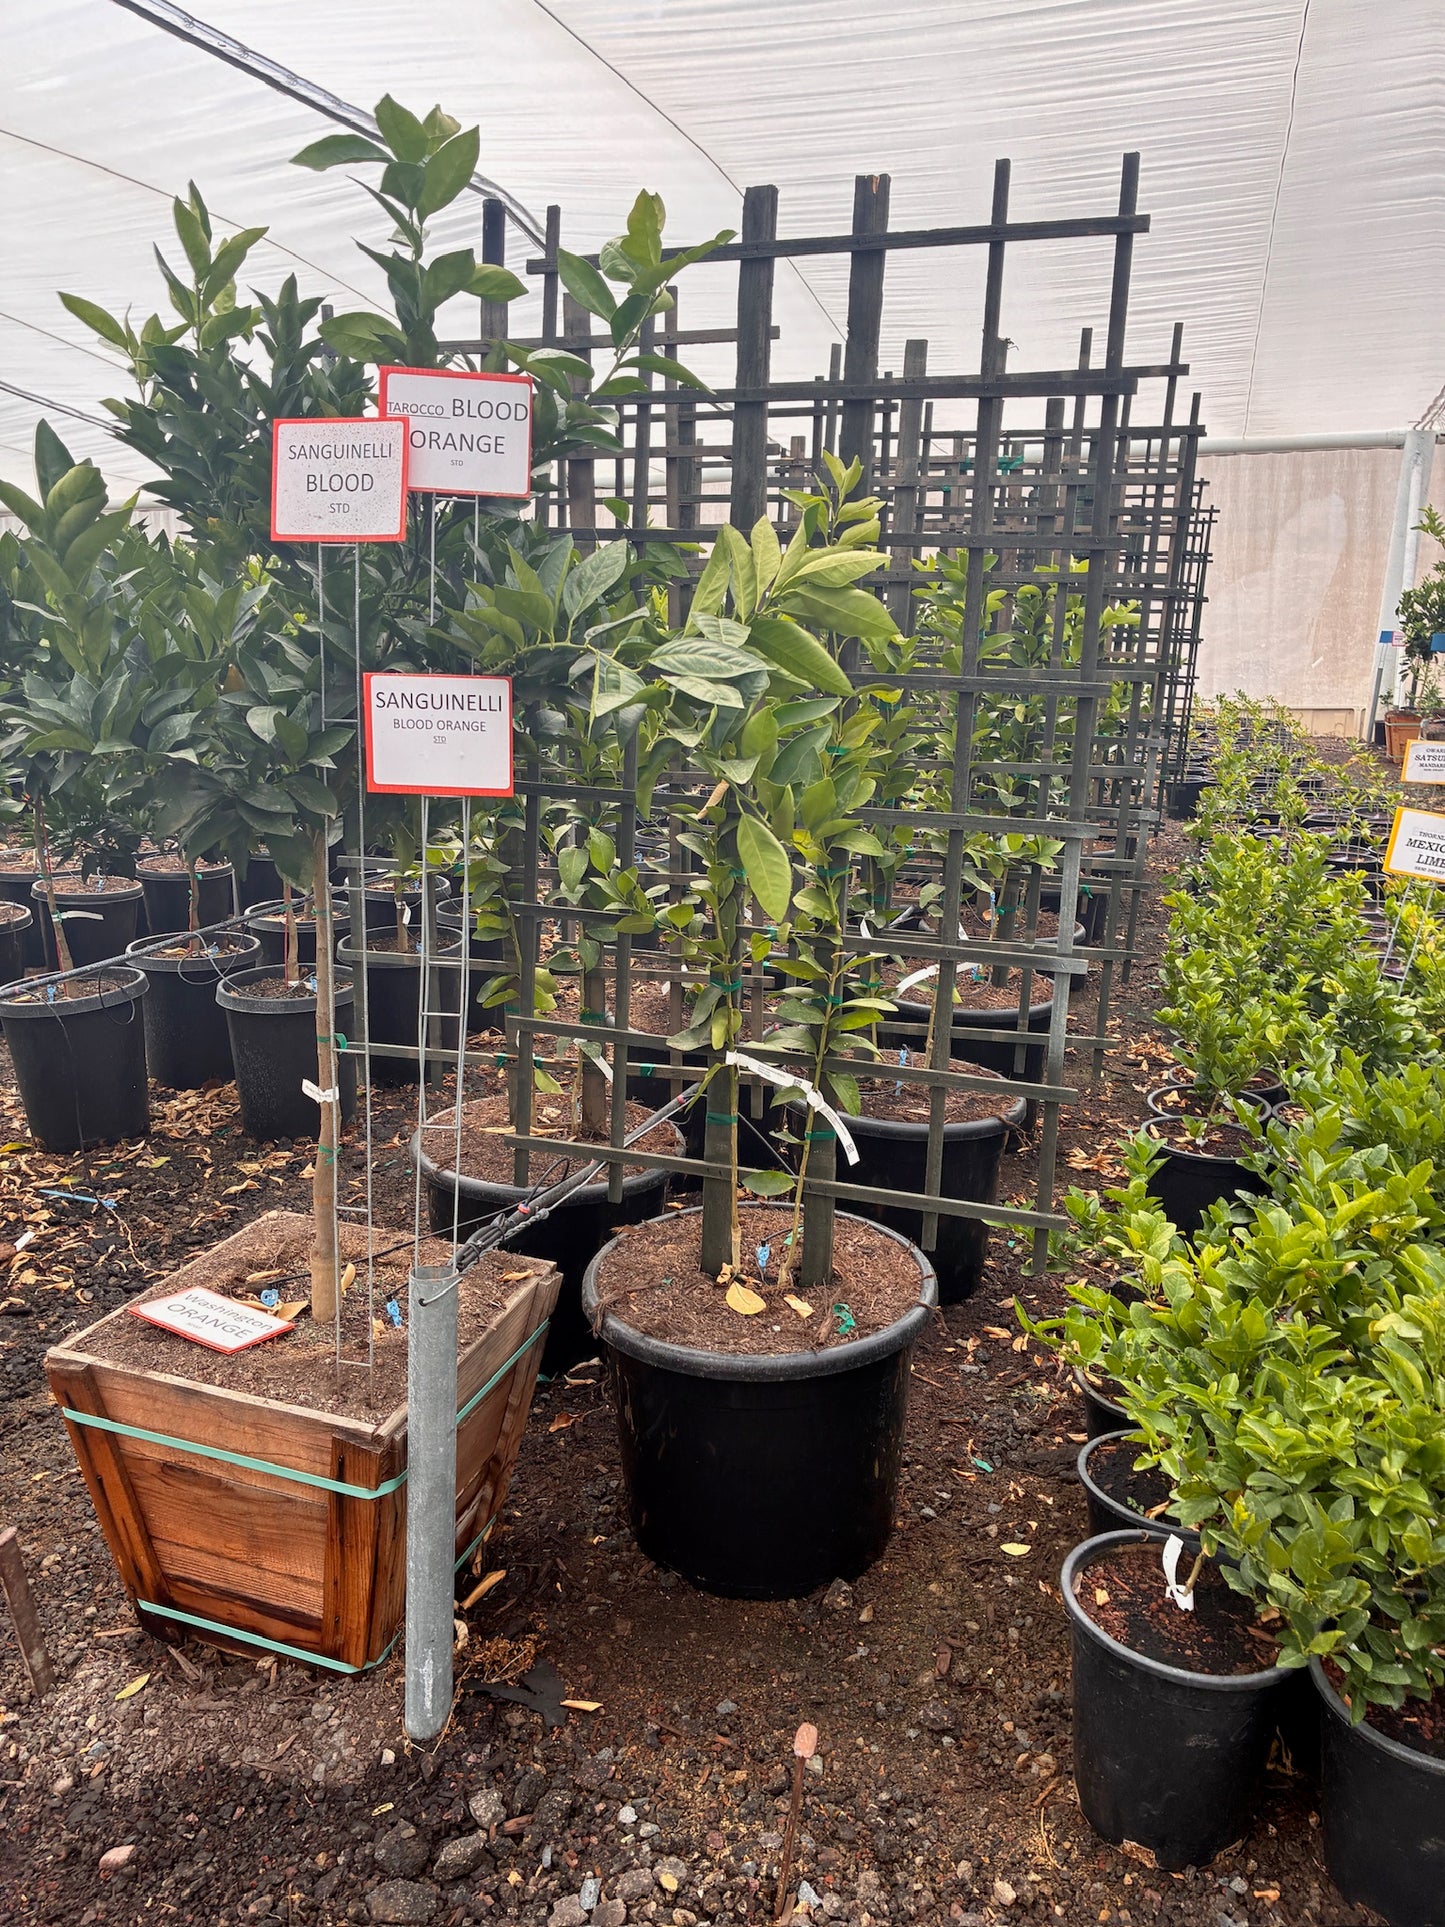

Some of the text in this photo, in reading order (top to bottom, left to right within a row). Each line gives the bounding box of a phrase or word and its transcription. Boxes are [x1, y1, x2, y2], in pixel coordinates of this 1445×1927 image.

[387, 398, 528, 422] TAROCCO BLOOD
[288, 443, 392, 460] SANGUINELLI
[410, 430, 506, 455] ORANGE
[450, 459, 464, 467] STD
[306, 473, 374, 492] BLOOD
[329, 502, 350, 514] STD
[375, 691, 502, 712] SANGUINELLI
[393, 718, 486, 732] BLOOD ORANGE
[167, 1303, 253, 1339] ORANGE
[184, 1293, 273, 1331] Washington
